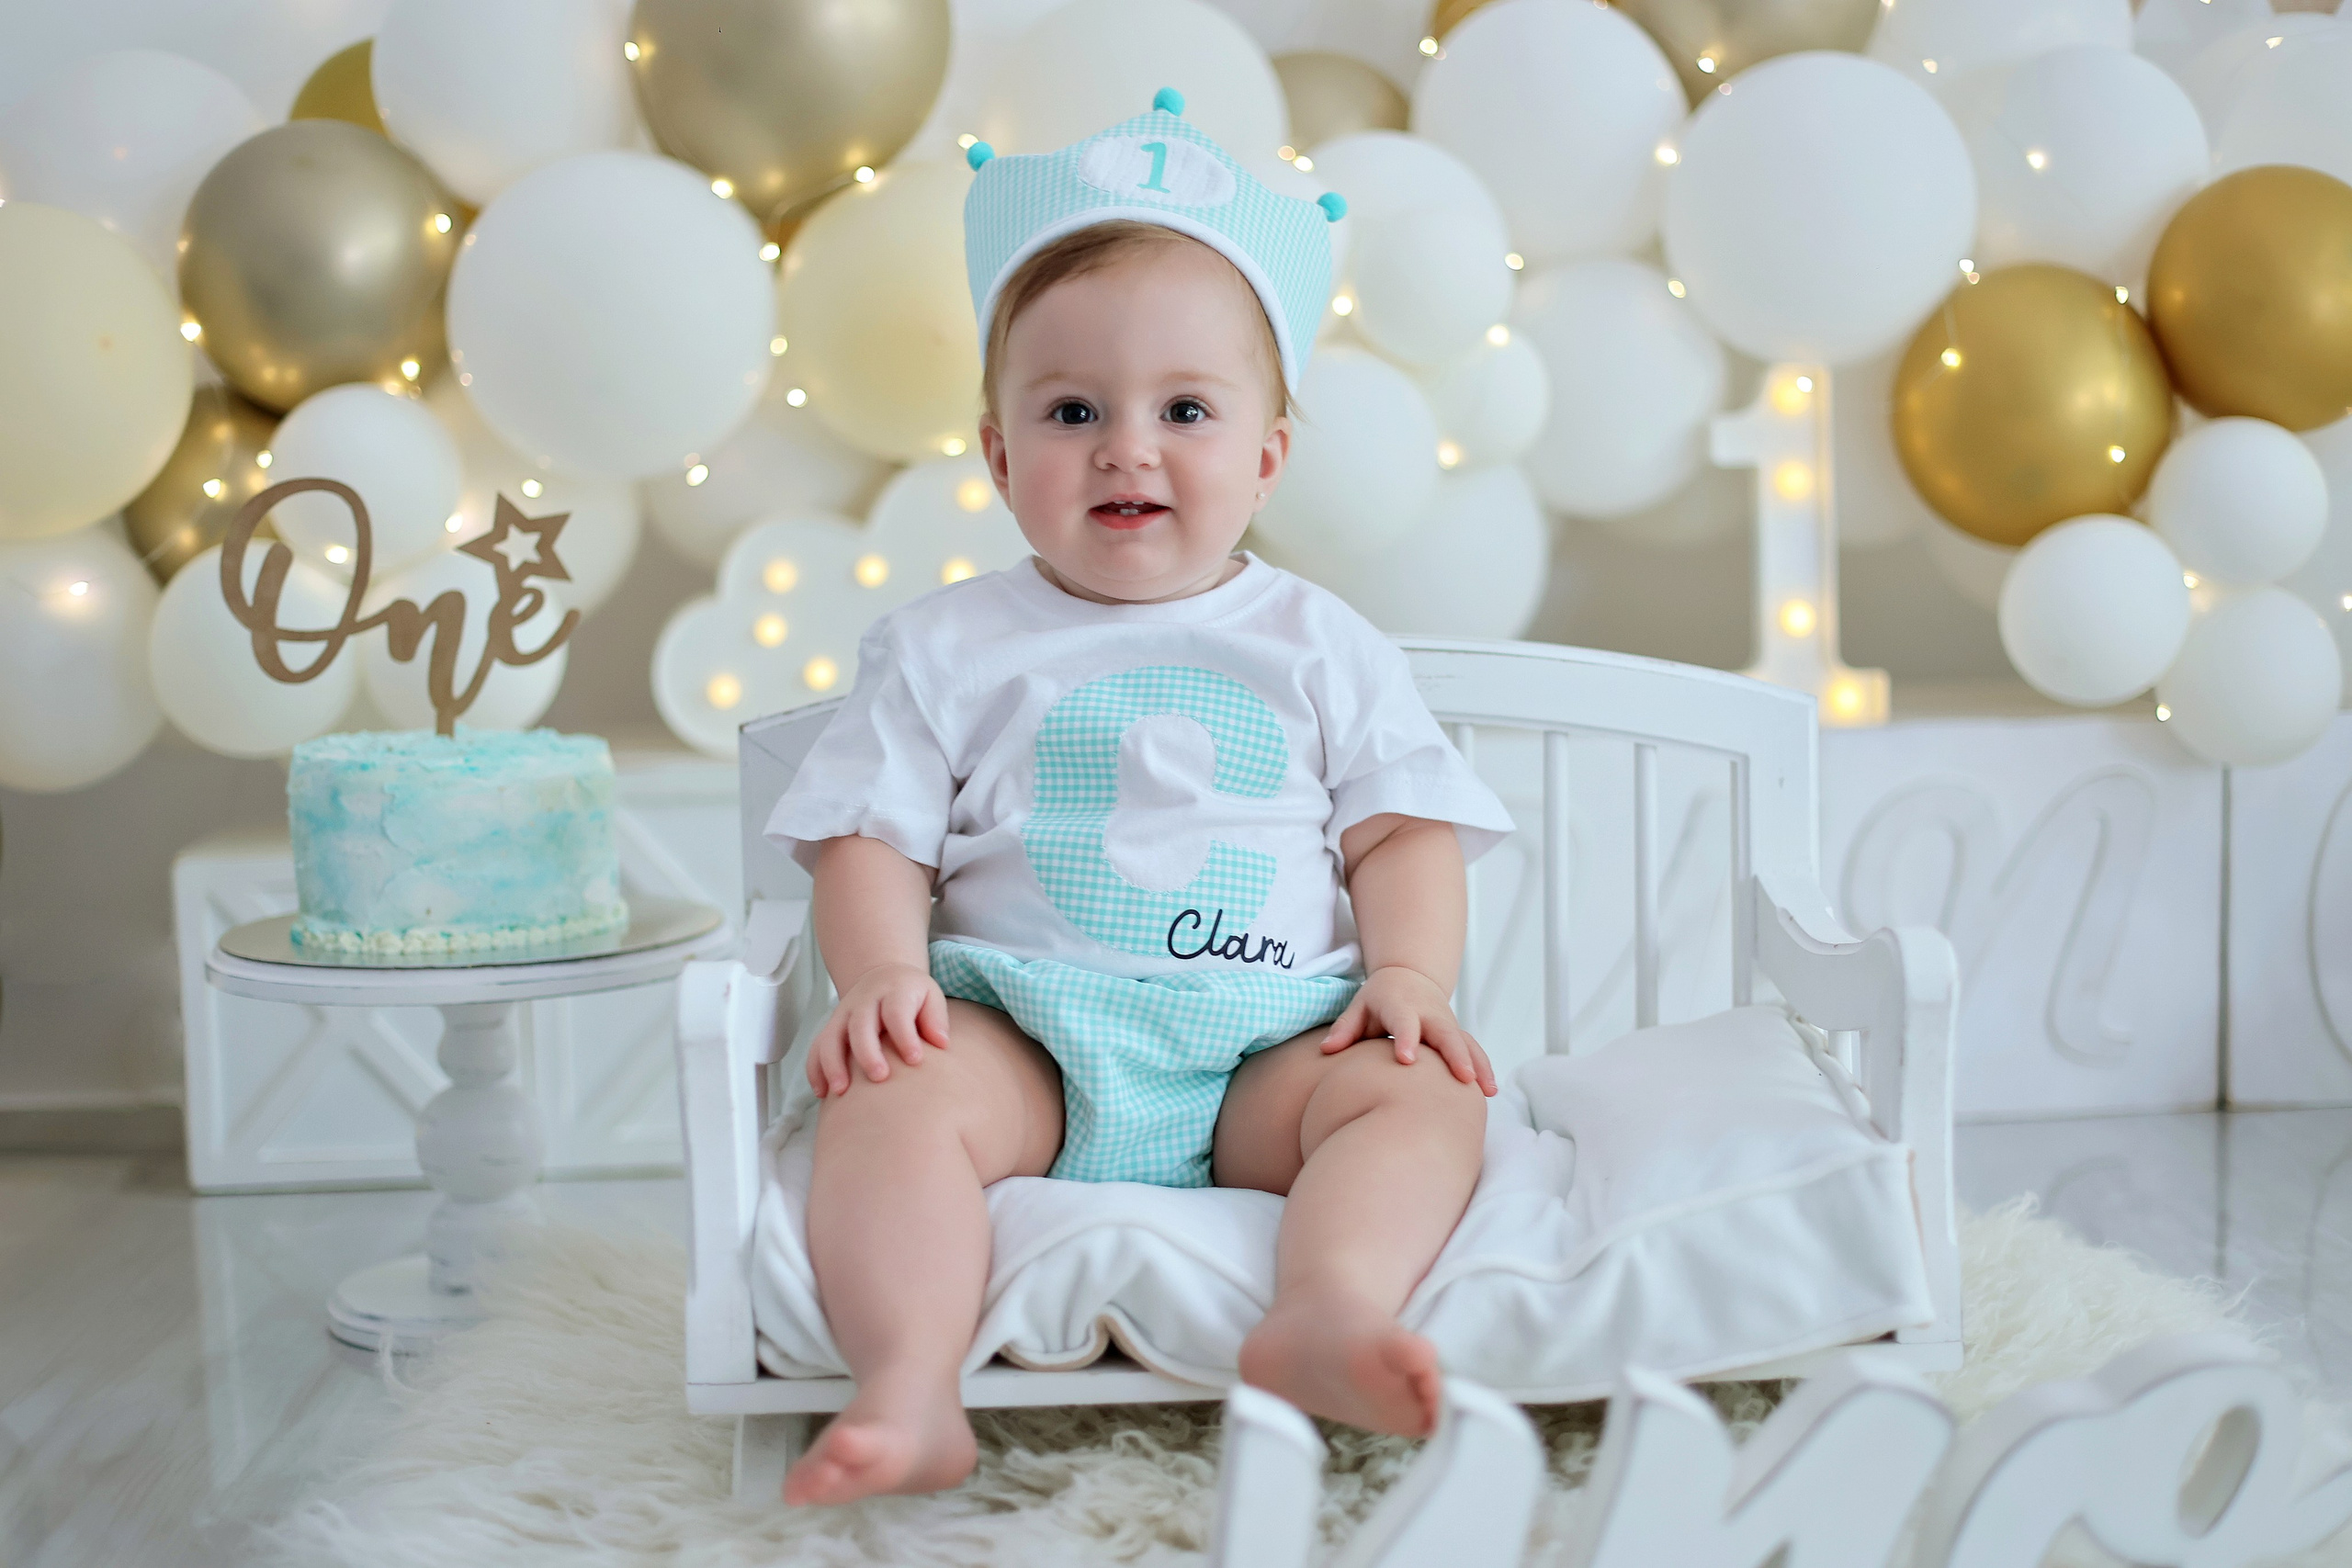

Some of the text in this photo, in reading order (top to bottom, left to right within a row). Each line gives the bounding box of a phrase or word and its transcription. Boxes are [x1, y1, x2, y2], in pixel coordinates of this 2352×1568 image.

[1136, 141, 1171, 194] 1
[220, 477, 582, 720] One
[1021, 665, 1289, 959] C
[1168, 908, 1295, 970] Clara
